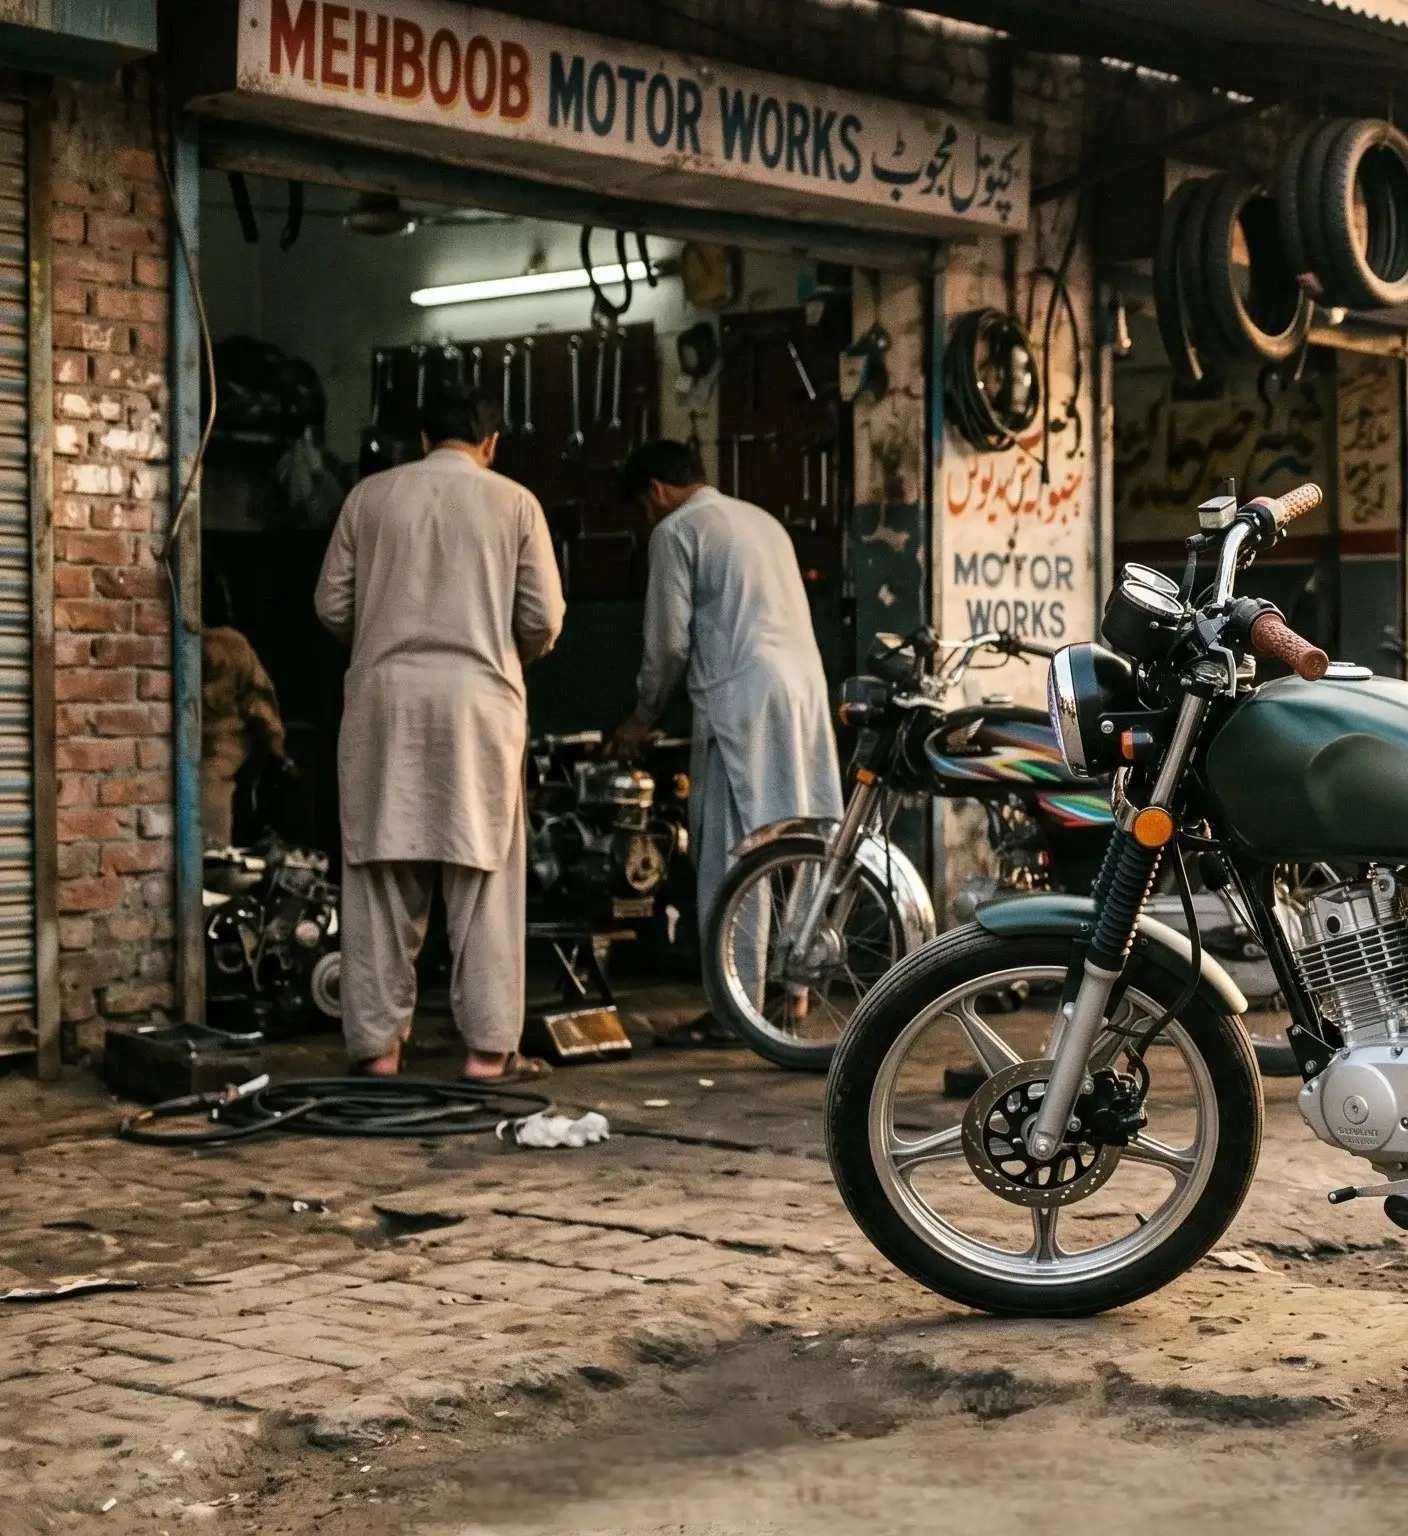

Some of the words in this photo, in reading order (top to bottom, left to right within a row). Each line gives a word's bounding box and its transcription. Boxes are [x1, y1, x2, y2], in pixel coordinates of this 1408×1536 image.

[269, 0, 533, 123] MEHBOOB
[548, 51, 702, 154] MOTOR
[718, 86, 862, 184] WORKS
[954, 553, 1074, 592] MOTOR
[966, 600, 1066, 639] WORKS
